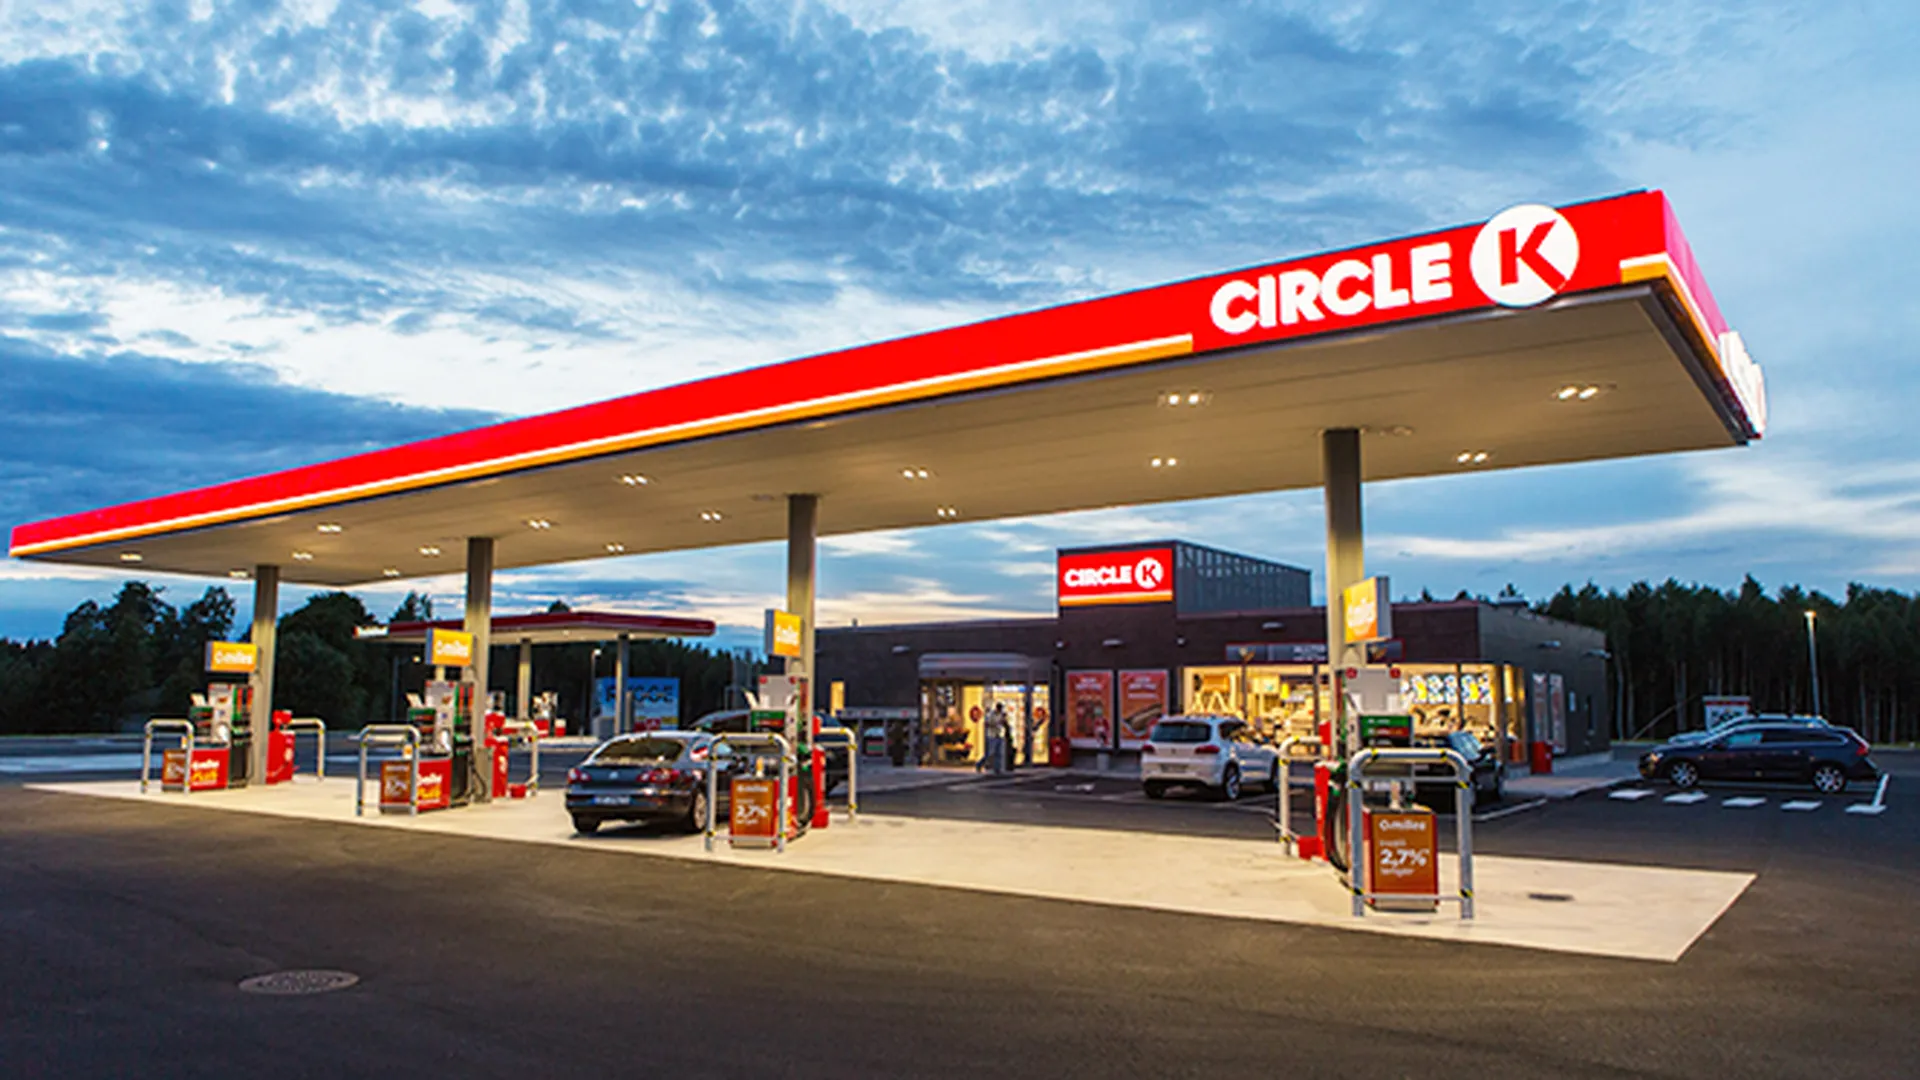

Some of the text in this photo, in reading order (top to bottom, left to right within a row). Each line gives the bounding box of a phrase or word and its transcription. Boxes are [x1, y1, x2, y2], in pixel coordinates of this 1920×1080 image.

[1210, 215, 1575, 334] CIRCLE K
[1064, 565, 1132, 587] CIRCLE
